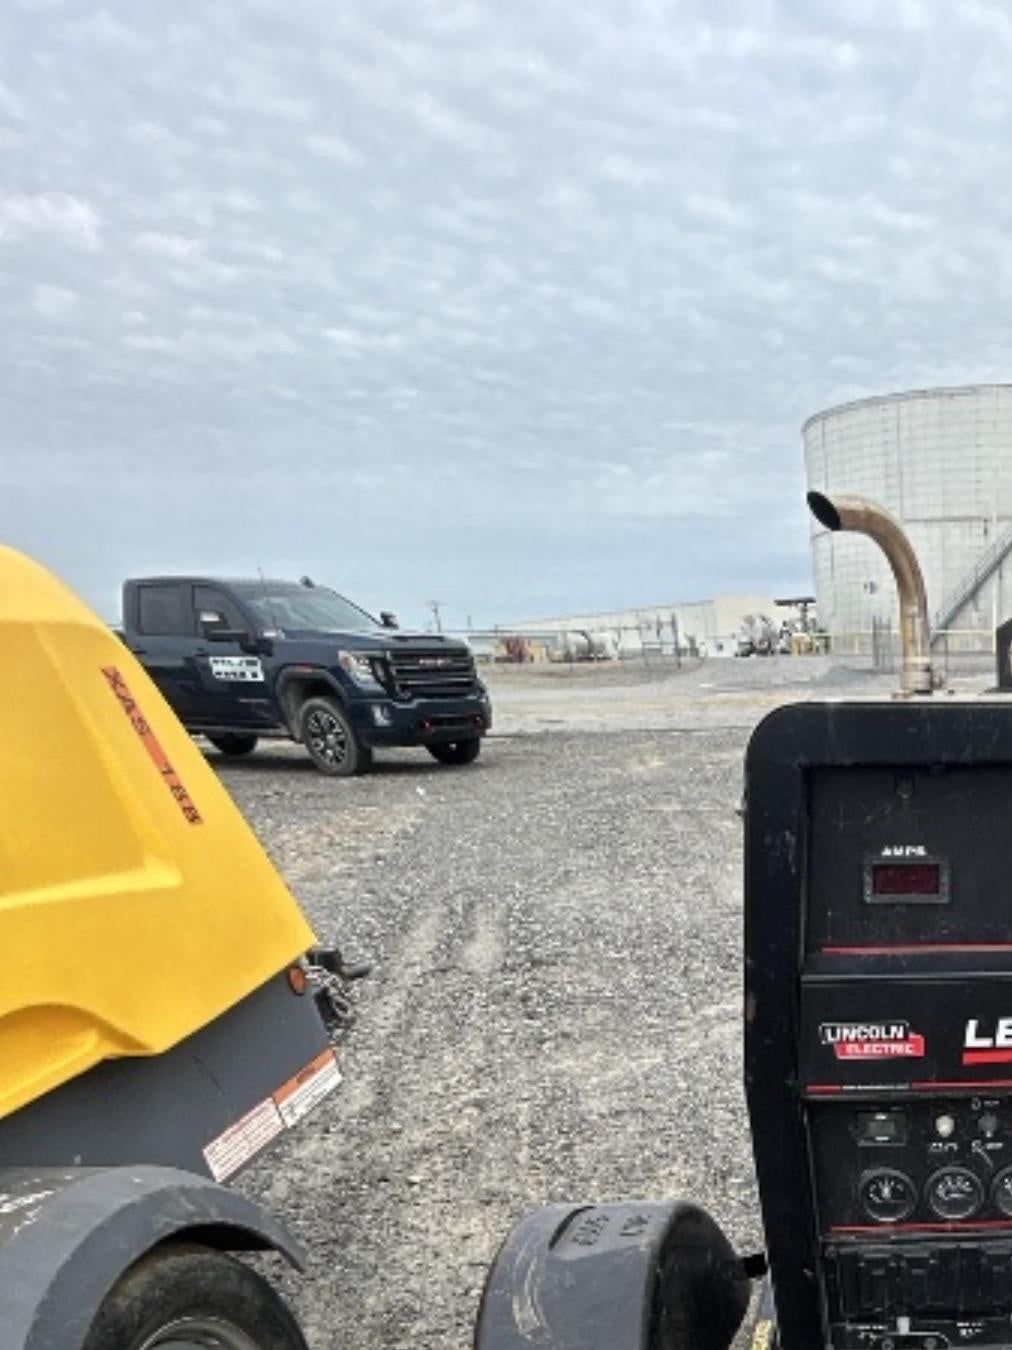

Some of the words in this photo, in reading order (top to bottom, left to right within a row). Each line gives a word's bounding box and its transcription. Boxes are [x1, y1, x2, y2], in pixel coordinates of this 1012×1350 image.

[881, 844, 928, 857] AMPS
[825, 1023, 906, 1043] LINCOLN
[845, 1042, 916, 1056] ELECTRIC
